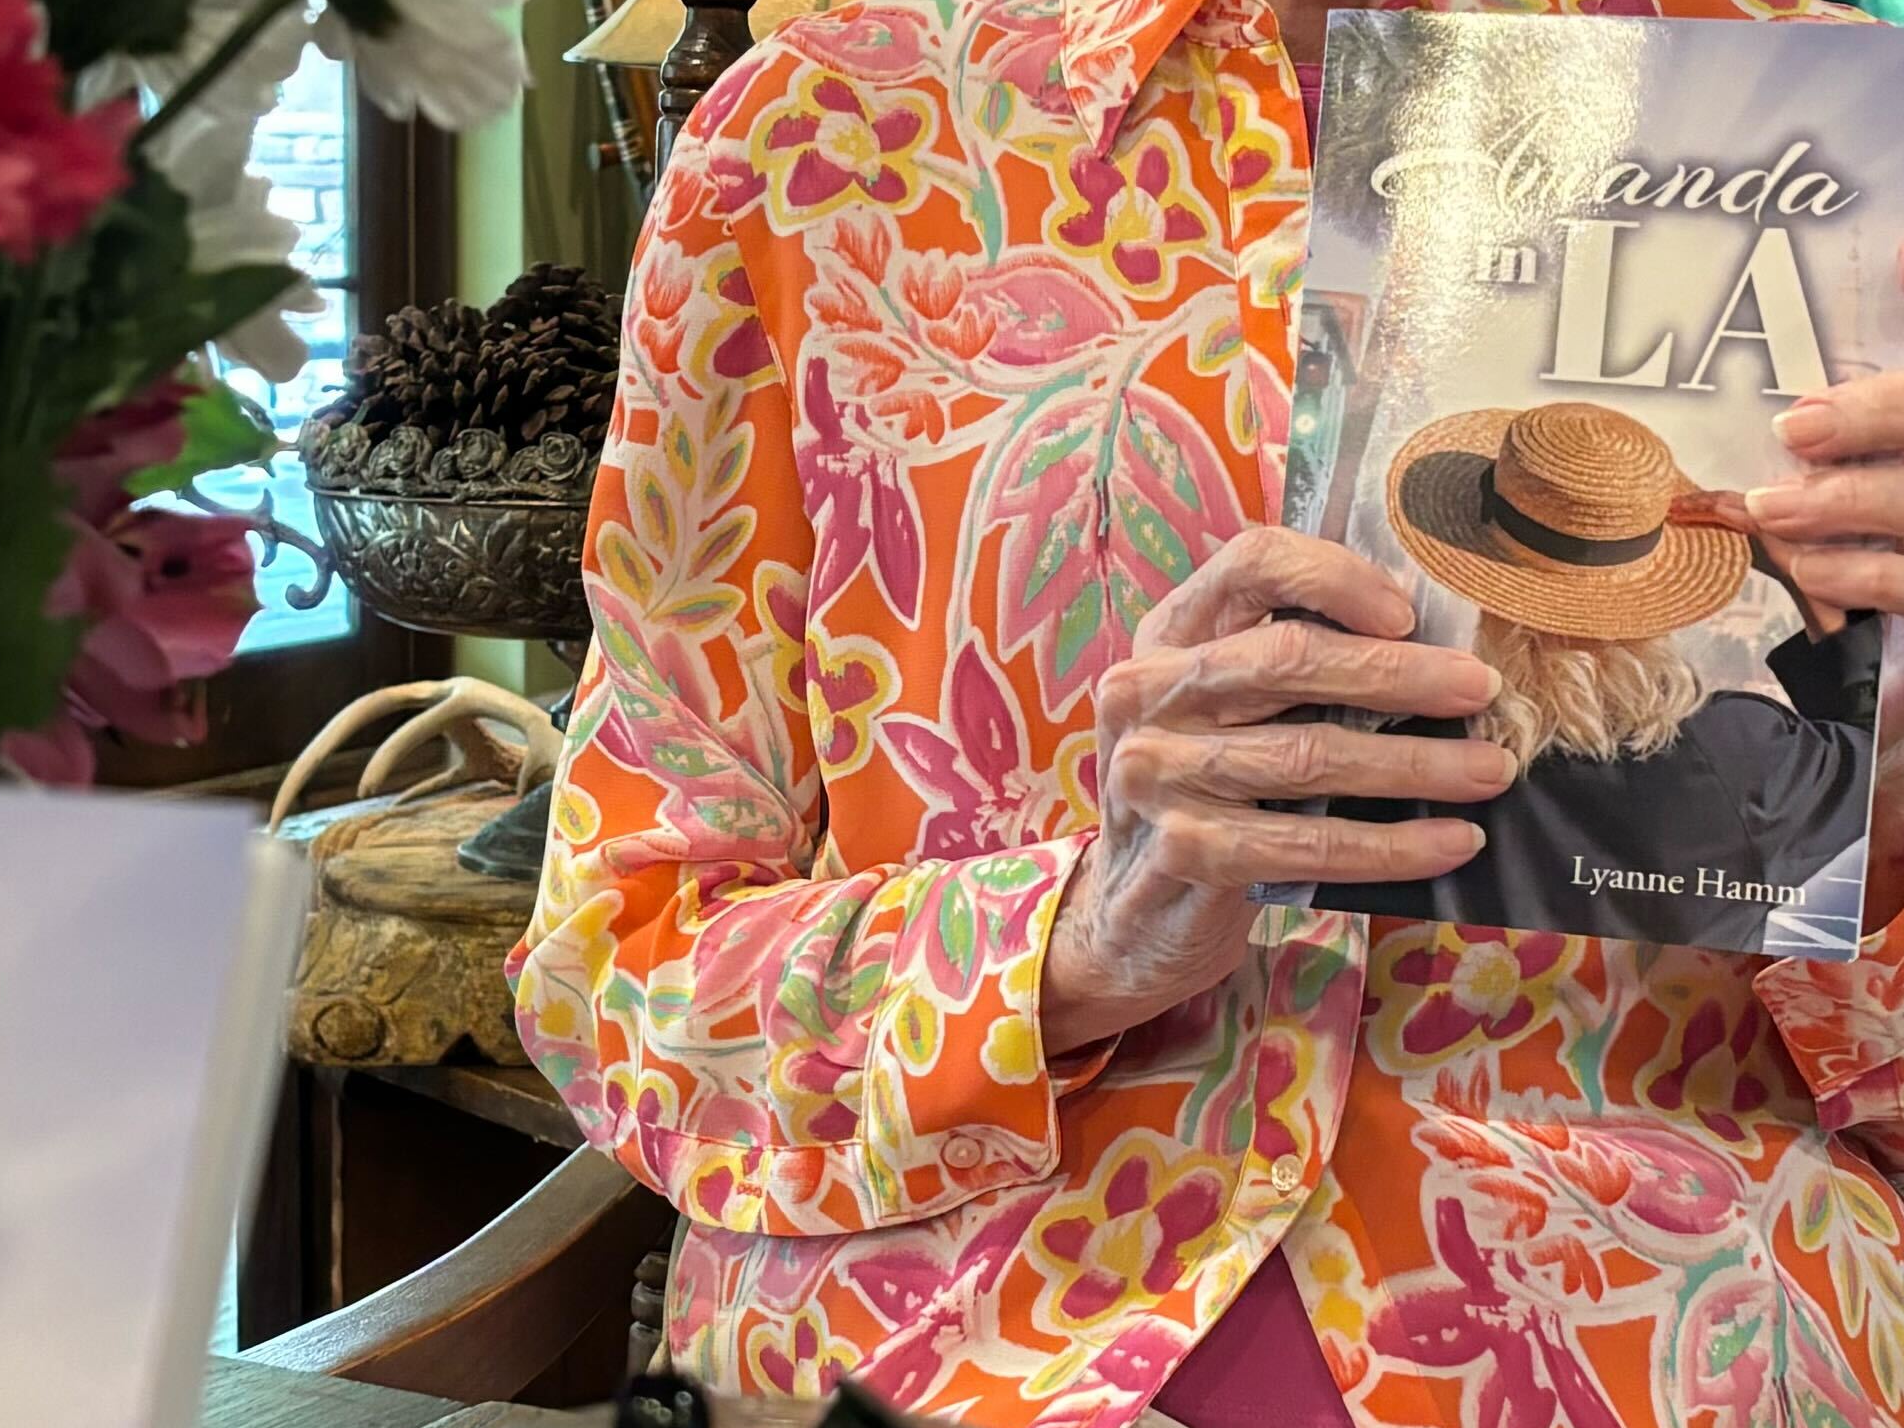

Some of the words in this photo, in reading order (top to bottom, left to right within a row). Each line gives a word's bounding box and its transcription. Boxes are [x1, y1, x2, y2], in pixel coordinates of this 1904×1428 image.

[1539, 218, 1832, 397] LA
[1570, 855, 1686, 895] Lyanne
[1694, 866, 1807, 907] Hamm
